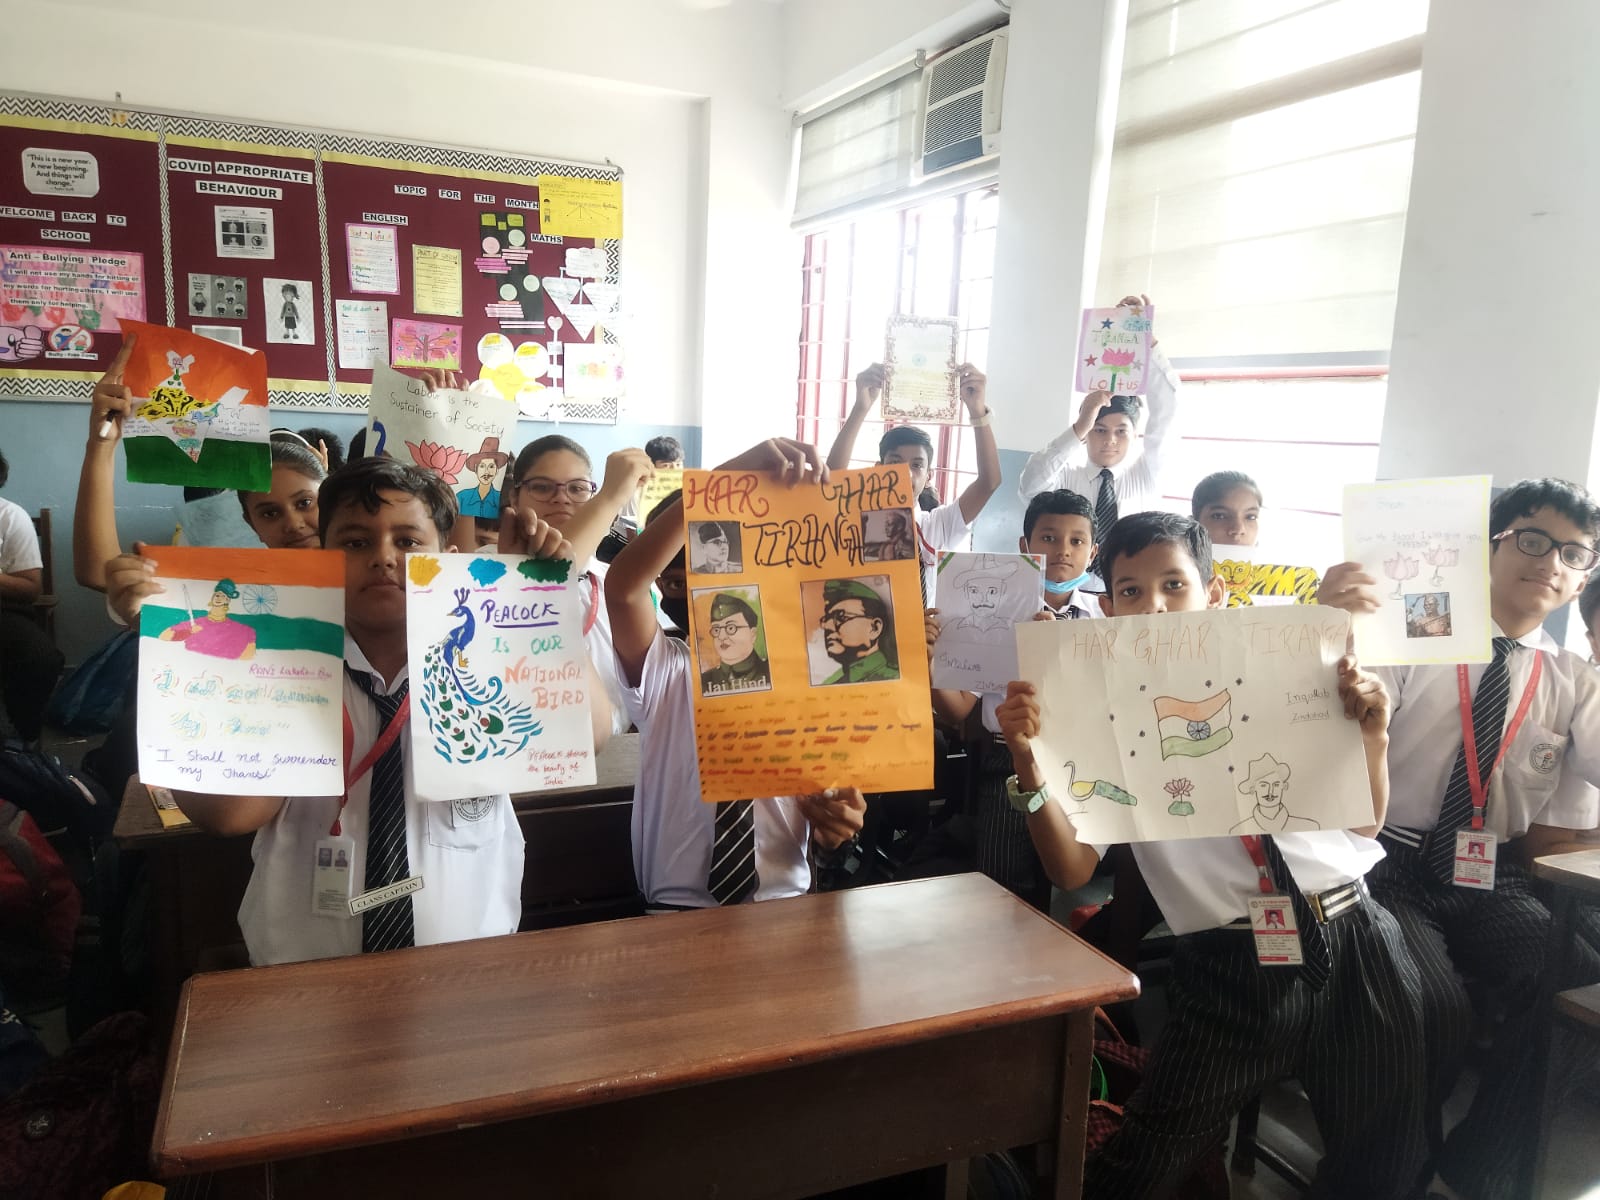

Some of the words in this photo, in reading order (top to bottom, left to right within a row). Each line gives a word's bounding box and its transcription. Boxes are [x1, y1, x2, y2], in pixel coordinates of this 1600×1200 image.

[169, 160, 211, 172] COVID
[217, 164, 309, 182] APPROPRIATE
[200, 182, 277, 198] BEHAVIOUR
[396, 186, 425, 195] TOPIC
[476, 194, 494, 203] THE
[507, 200, 539, 209] MONTH
[63, 213, 94, 221] BACK
[109, 216, 124, 224] TO
[364, 214, 406, 224] ENGLISH
[42, 230, 89, 240] SCHOOL
[532, 234, 562, 243] MATHS
[10, 252, 31, 260] Anti
[43, 254, 84, 264] Bullying
[92, 257, 126, 266] Pledge
[448, 395, 456, 404] is
[464, 396, 479, 408] the
[686, 474, 770, 517] HAR
[821, 470, 907, 516] GHAR
[743, 513, 865, 568] TIRANGA
[480, 598, 560, 624] PEACOCK
[530, 635, 565, 654] OUR
[1073, 628, 1119, 663] HAR
[1134, 620, 1211, 665] GHAR
[505, 656, 583, 684] NATIONAL
[706, 679, 726, 694] Jai
[731, 675, 767, 692] Hind
[531, 687, 584, 710] BIRD
[236, 752, 261, 762] not
